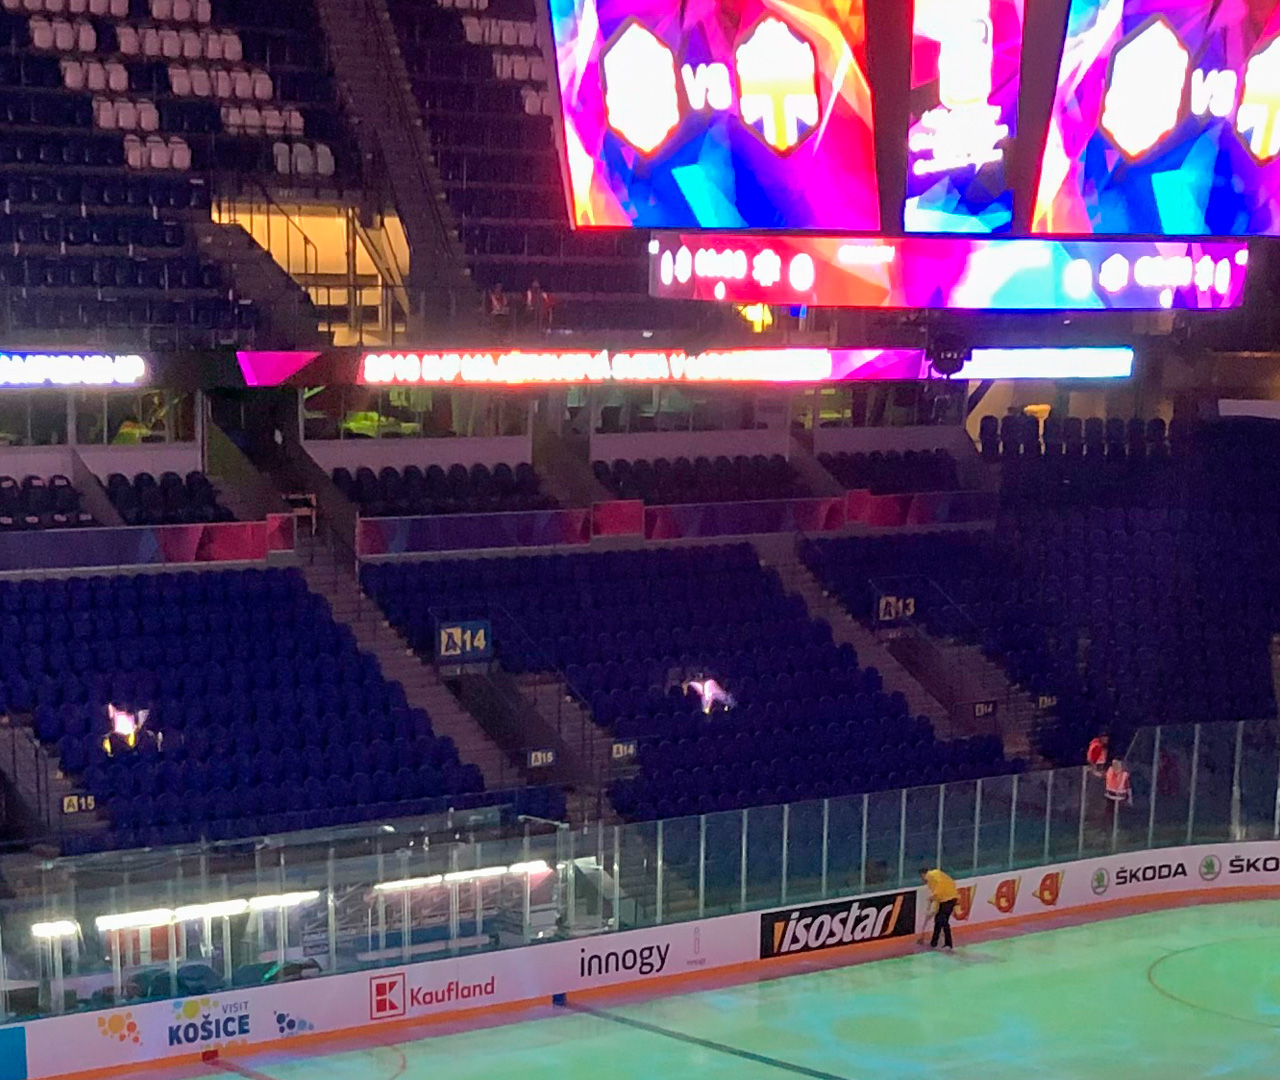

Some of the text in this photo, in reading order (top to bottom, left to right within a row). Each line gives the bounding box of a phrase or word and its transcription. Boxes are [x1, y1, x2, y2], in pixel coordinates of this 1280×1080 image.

[462, 629, 487, 651] 14
[1114, 859, 1188, 885] ŠKODA
[780, 902, 894, 953] isostar
[580, 943, 670, 977] innogy
[410, 976, 495, 1006] Kaufland
[222, 1001, 249, 1014] VISIT
[168, 1014, 250, 1046] KOŠICE
